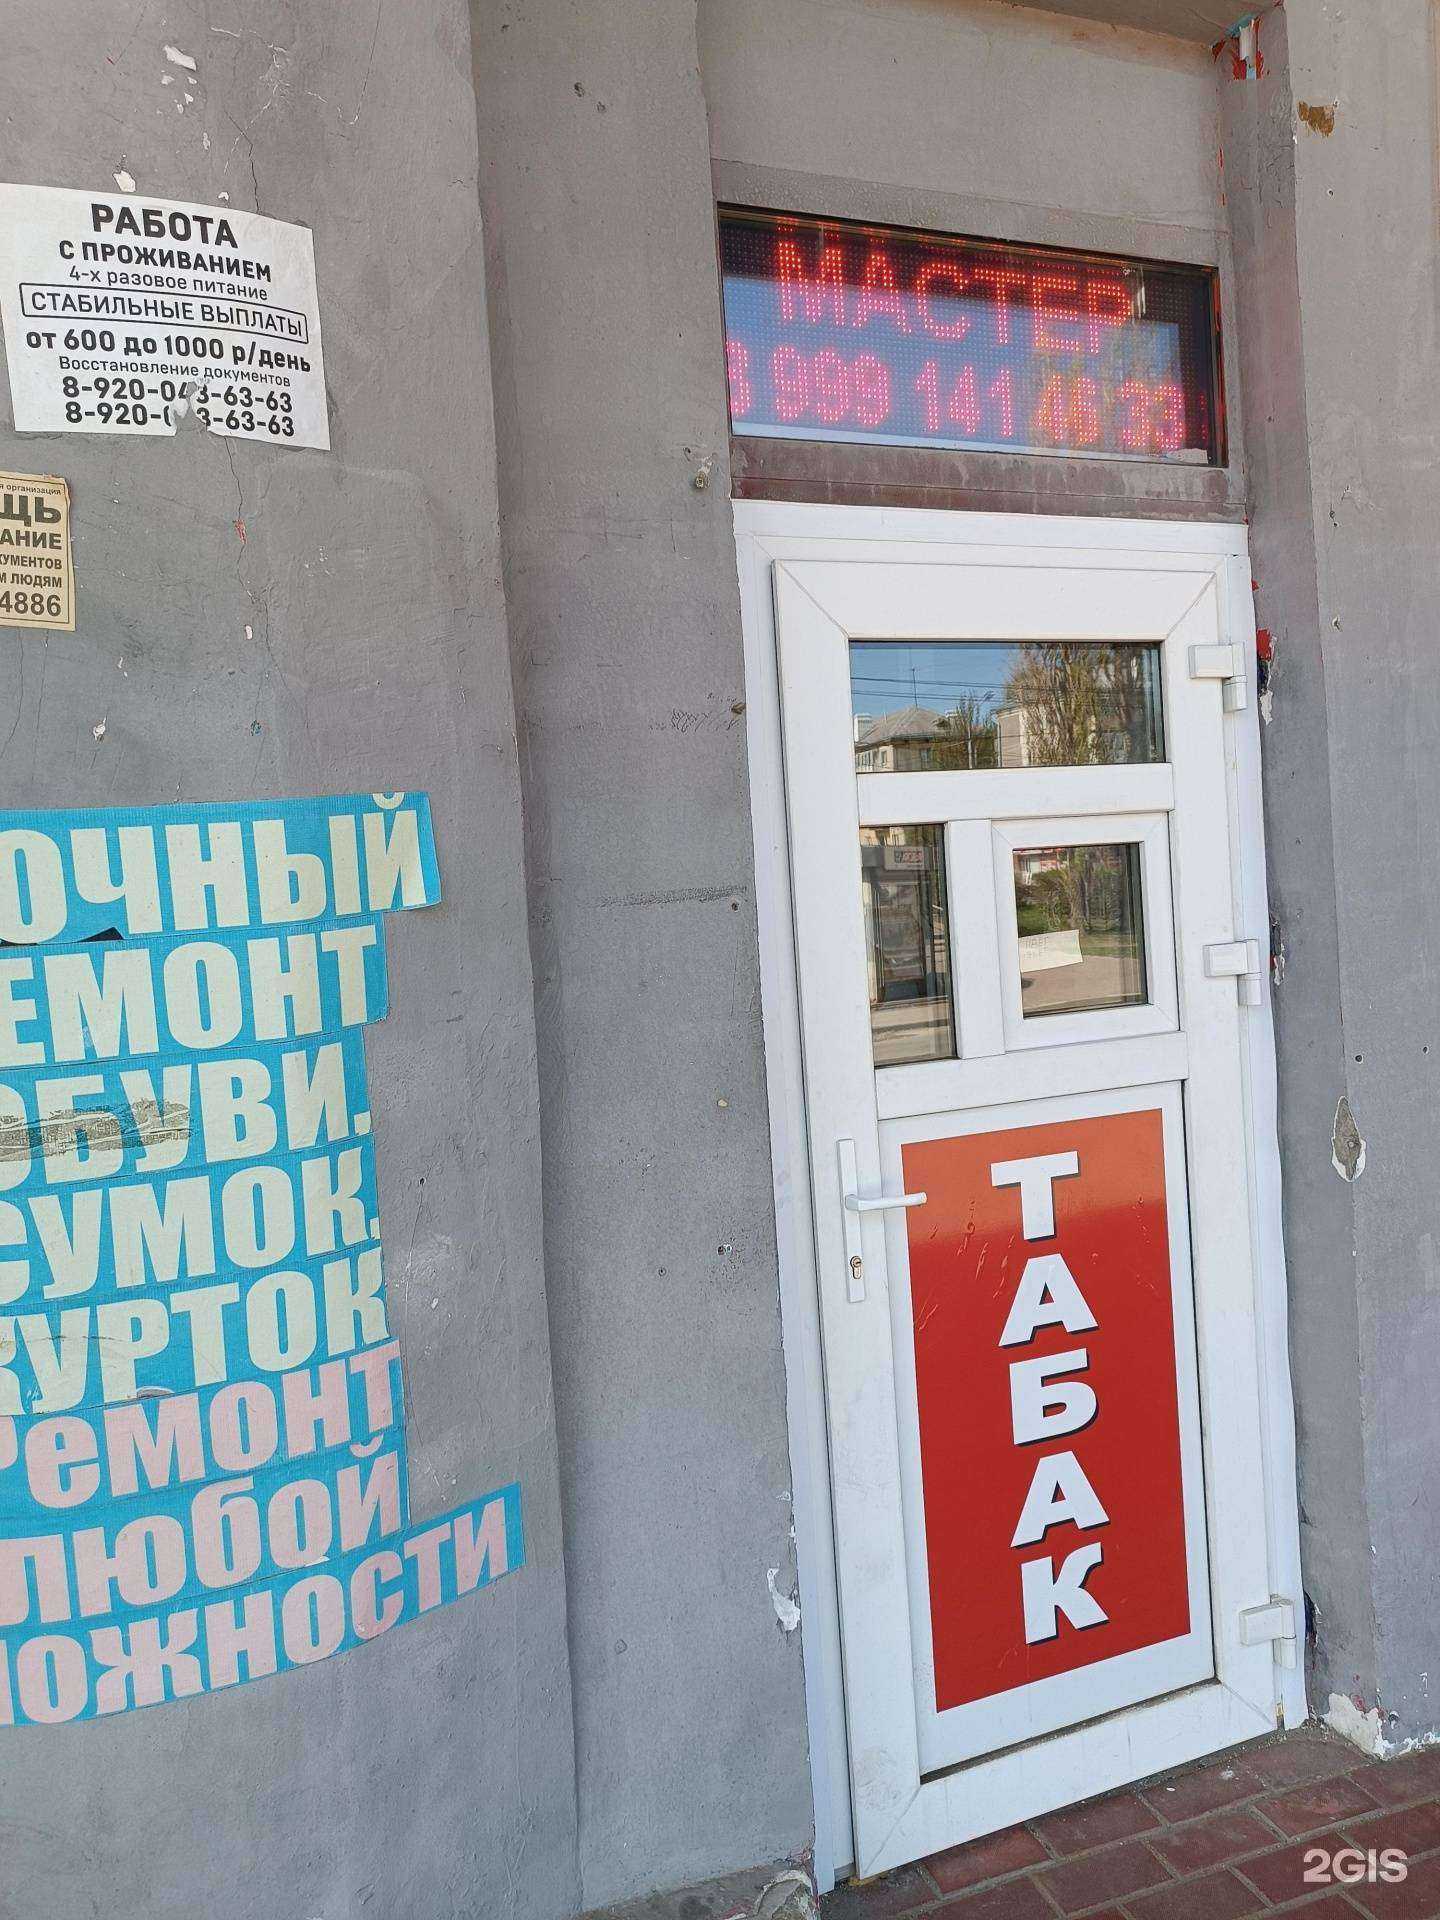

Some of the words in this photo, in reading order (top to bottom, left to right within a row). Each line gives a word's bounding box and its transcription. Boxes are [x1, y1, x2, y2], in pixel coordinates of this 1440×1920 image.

[91, 203, 238, 248] РАБОТА
[59, 240, 74, 259] С
[82, 241, 272, 282] ПРОЖИВАНИЕМ
[69, 265, 101, 282] 4-х
[108, 270, 187, 290] разовое
[193, 279, 267, 300] питание
[31, 292, 194, 321] СТАБИЛЬНЫЕ
[201, 306, 301, 337] ВЫПЛАТЫ
[778, 241, 1132, 354] МАСТЕР
[26, 331, 56, 349] от
[64, 329, 116, 351] 600
[123, 338, 157, 356] до
[164, 335, 224, 359] 1000
[232, 341, 311, 372] р/день
[59, 356, 199, 376] Восстановление
[203, 366, 290, 387] документов
[772, 347, 889, 425] 999
[915, 359, 1014, 437] 141
[6, 484, 61, 495] организация
[10, 573, 62, 588] ЛЮДЯМ
[0, 591, 62, 617] 4886
[0, 792, 426, 944] ОЧНЫЙ
[991, 1150, 1110, 1645] ТАБАК
